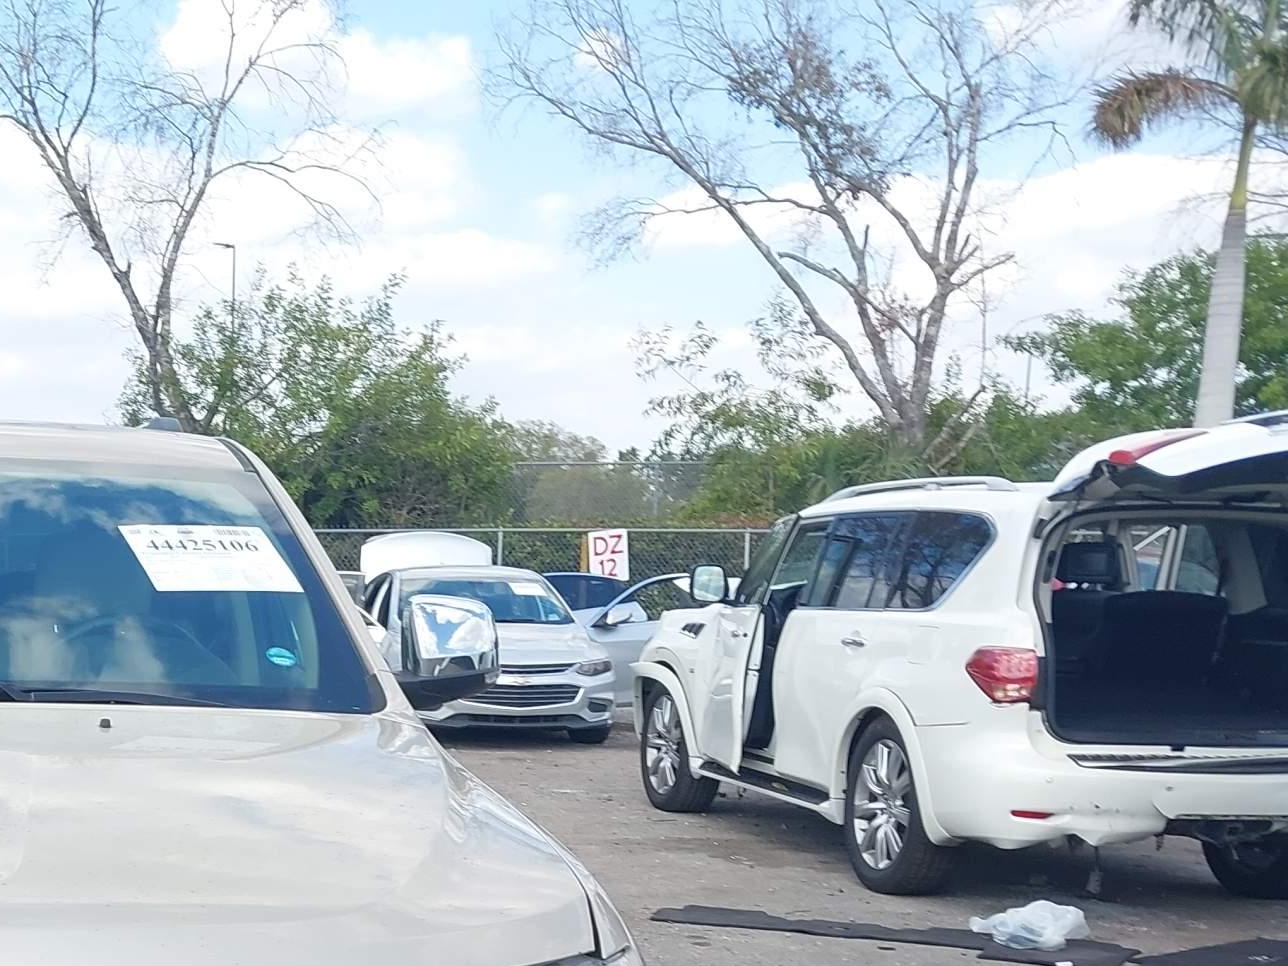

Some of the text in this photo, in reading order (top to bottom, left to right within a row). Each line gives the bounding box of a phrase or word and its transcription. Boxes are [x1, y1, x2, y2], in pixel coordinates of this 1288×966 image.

[146, 539, 260, 552] 44425106
[593, 534, 624, 556] DZ
[599, 558, 618, 577] 12
